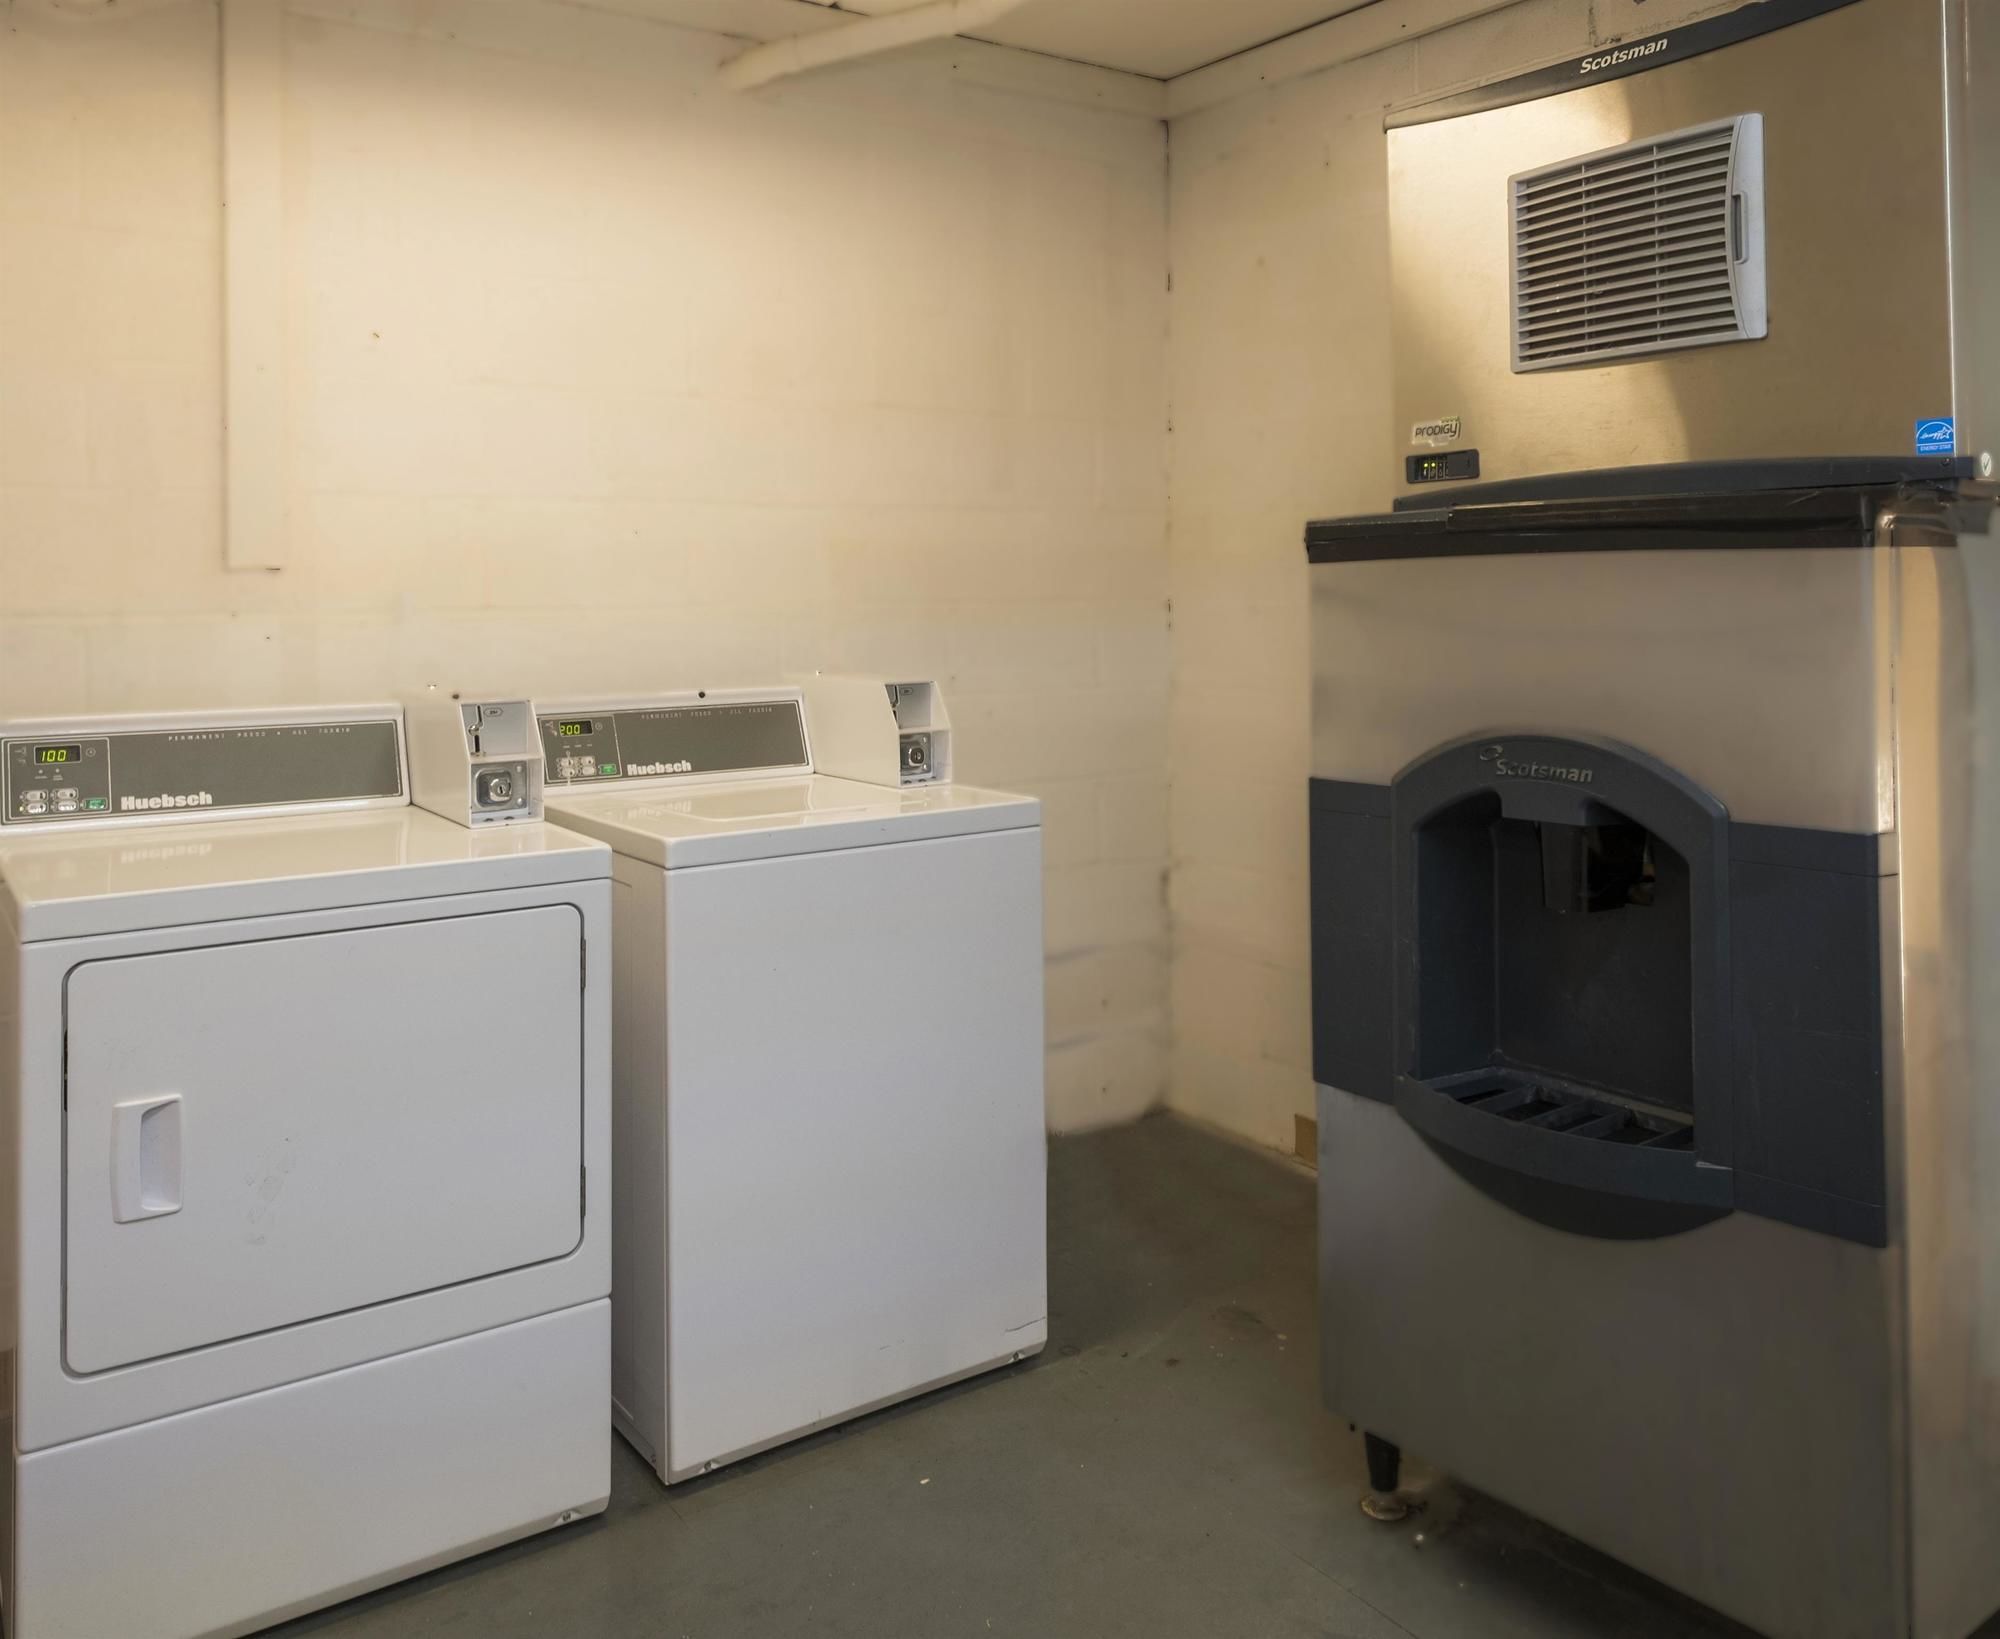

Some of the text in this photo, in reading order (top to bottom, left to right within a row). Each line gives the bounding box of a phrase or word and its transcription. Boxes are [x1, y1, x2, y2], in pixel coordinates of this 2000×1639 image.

[1580, 38, 1668, 73] Scotsman
[41, 749, 67, 762] 100
[627, 760, 692, 776] Huebsch
[1496, 758, 1592, 782] Scotsman
[120, 791, 213, 811] Huebsch
